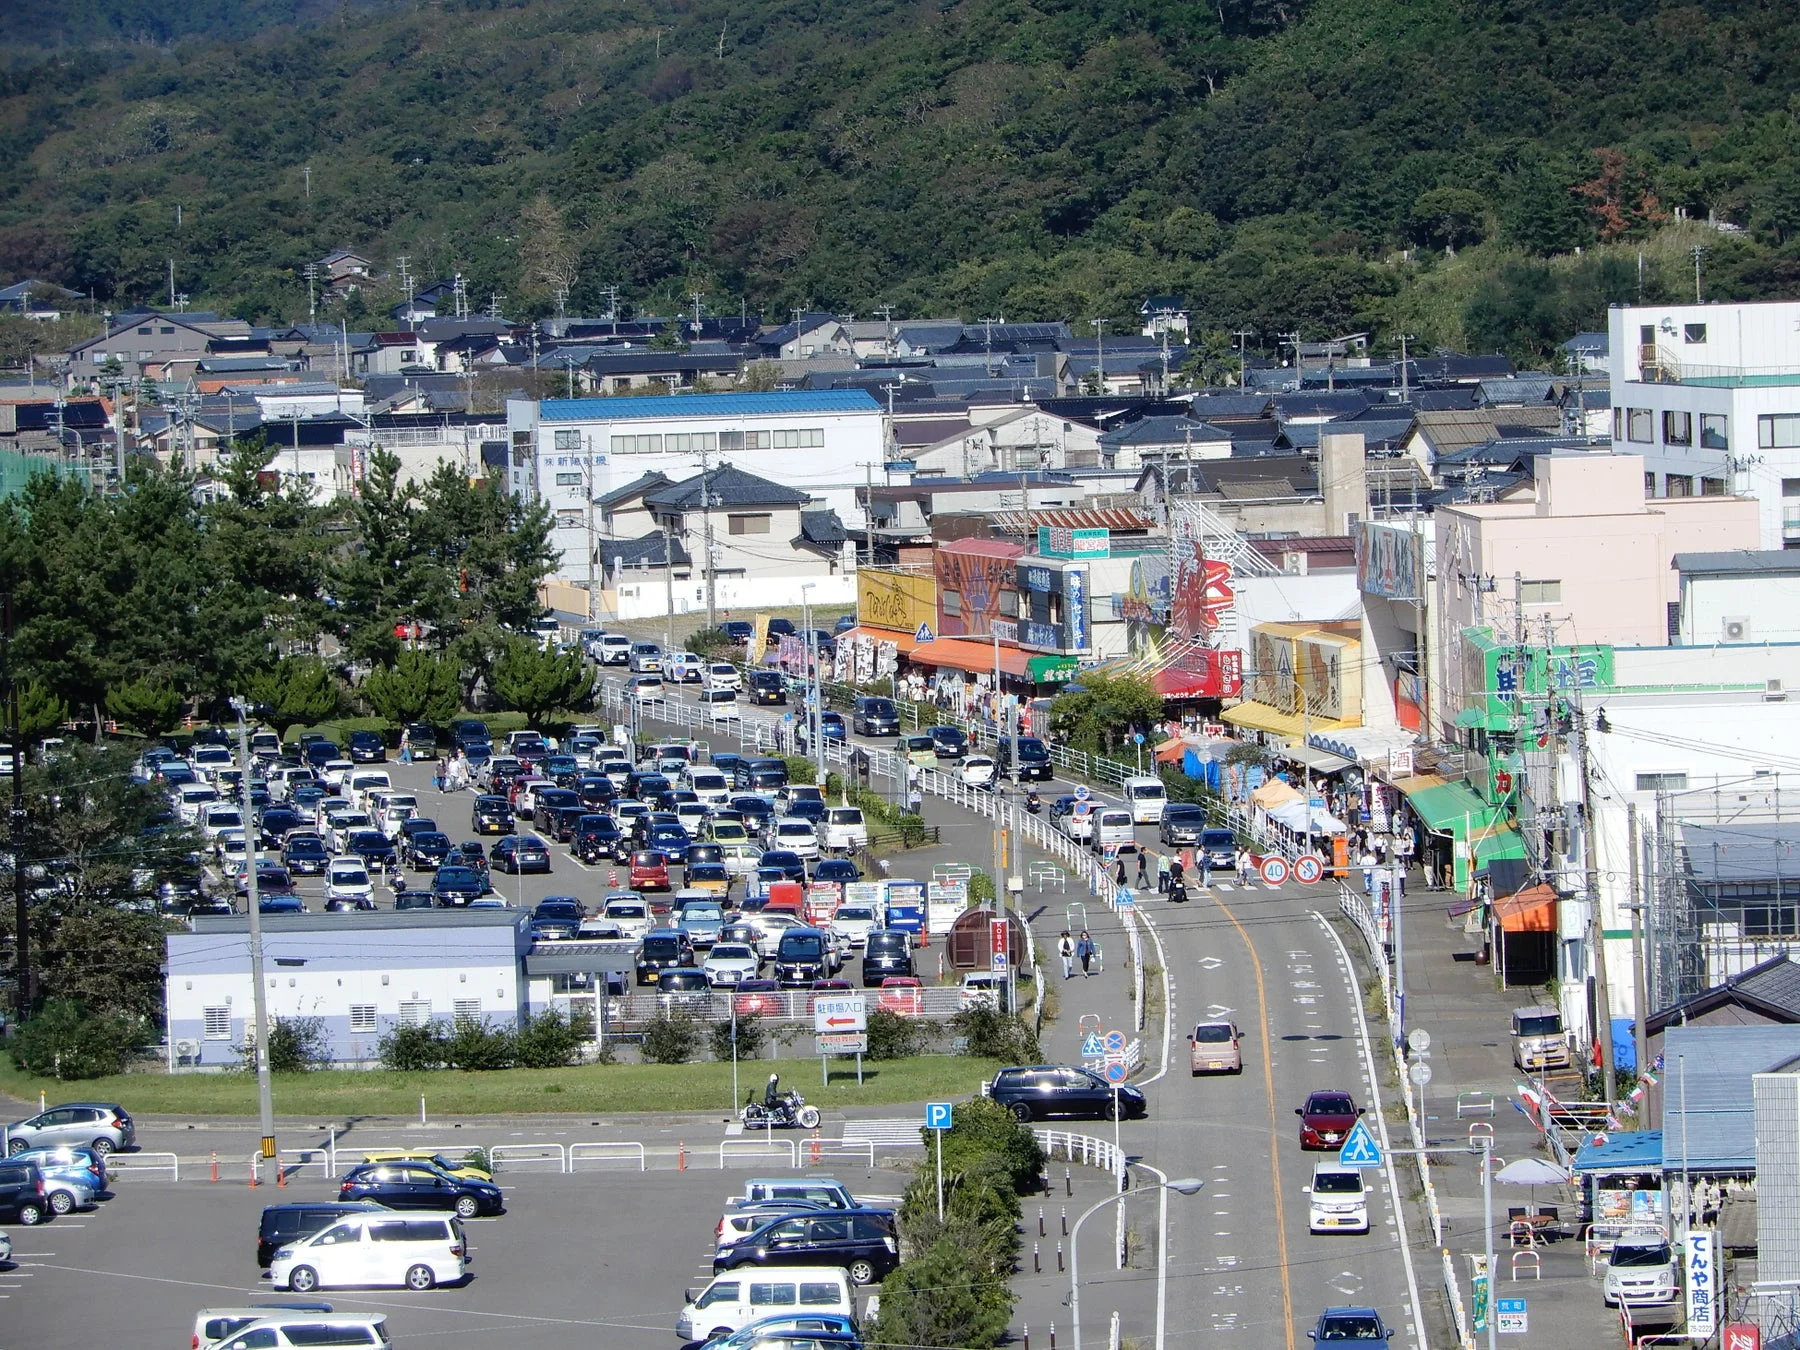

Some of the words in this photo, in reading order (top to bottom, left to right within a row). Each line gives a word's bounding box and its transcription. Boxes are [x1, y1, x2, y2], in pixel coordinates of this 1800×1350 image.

[1390, 751, 1409, 769] 酒
[1267, 864, 1283, 877] 40
[817, 1003, 862, 1014] 駐車場入口
[932, 1106, 947, 1126] P
[1690, 1235, 1710, 1322] てんや商店
